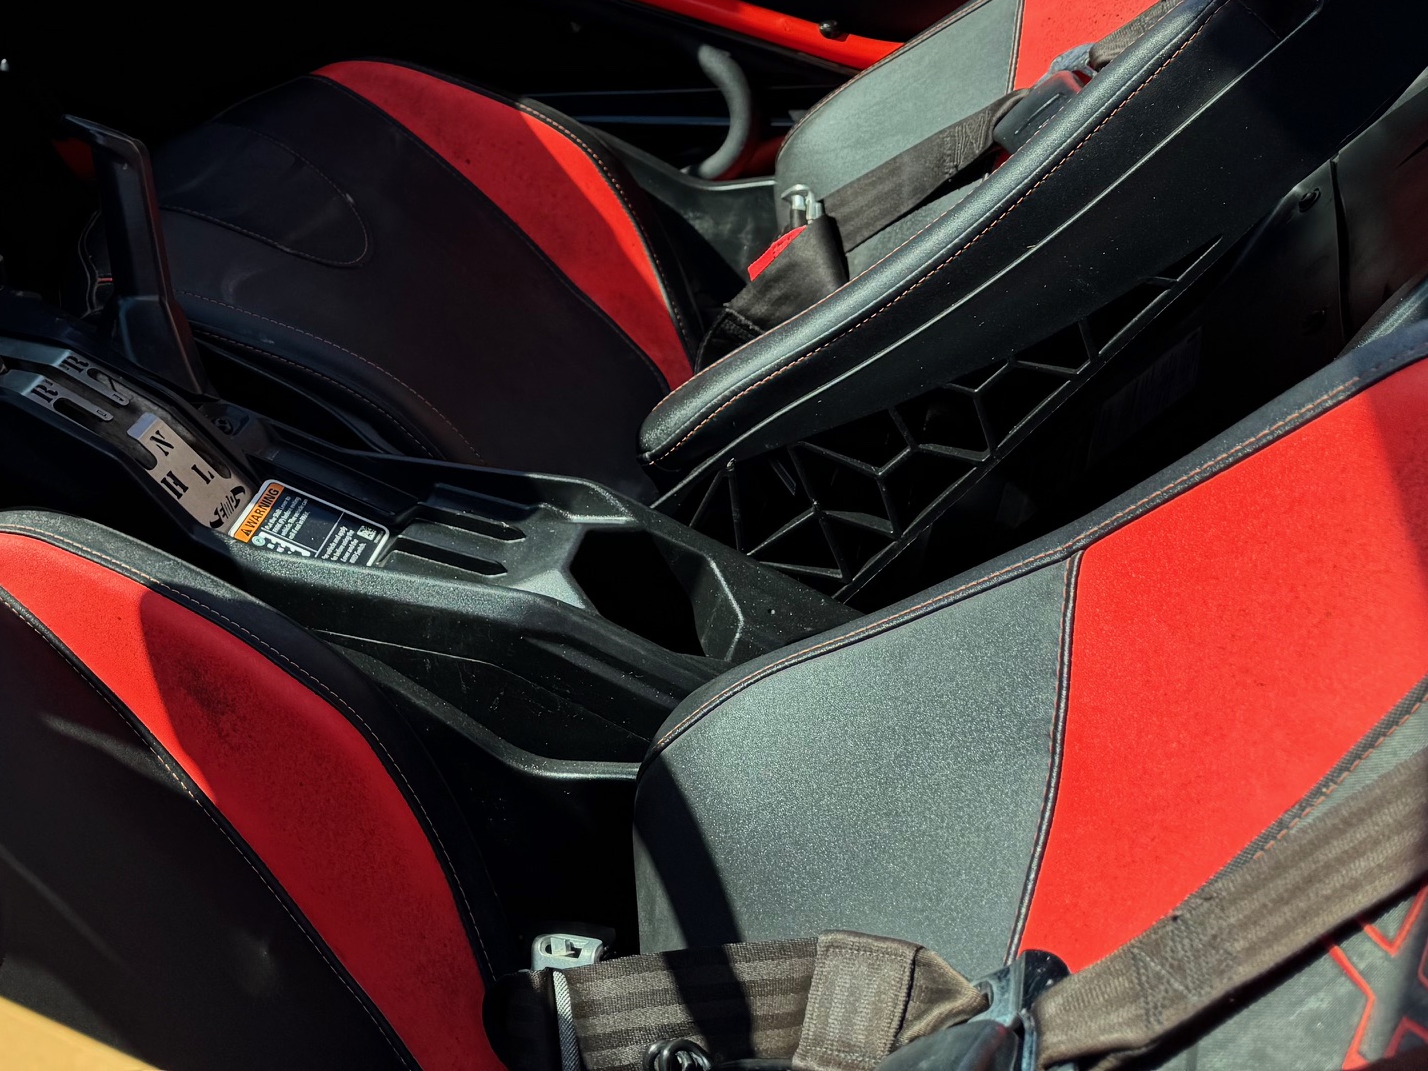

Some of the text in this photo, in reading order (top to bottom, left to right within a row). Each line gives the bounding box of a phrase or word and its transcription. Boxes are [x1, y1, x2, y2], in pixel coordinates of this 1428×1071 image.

[31, 380, 58, 404] R
[149, 429, 174, 456] N
[160, 470, 189, 500] H
[191, 464, 215, 485] L
[245, 487, 279, 529] WARNING
